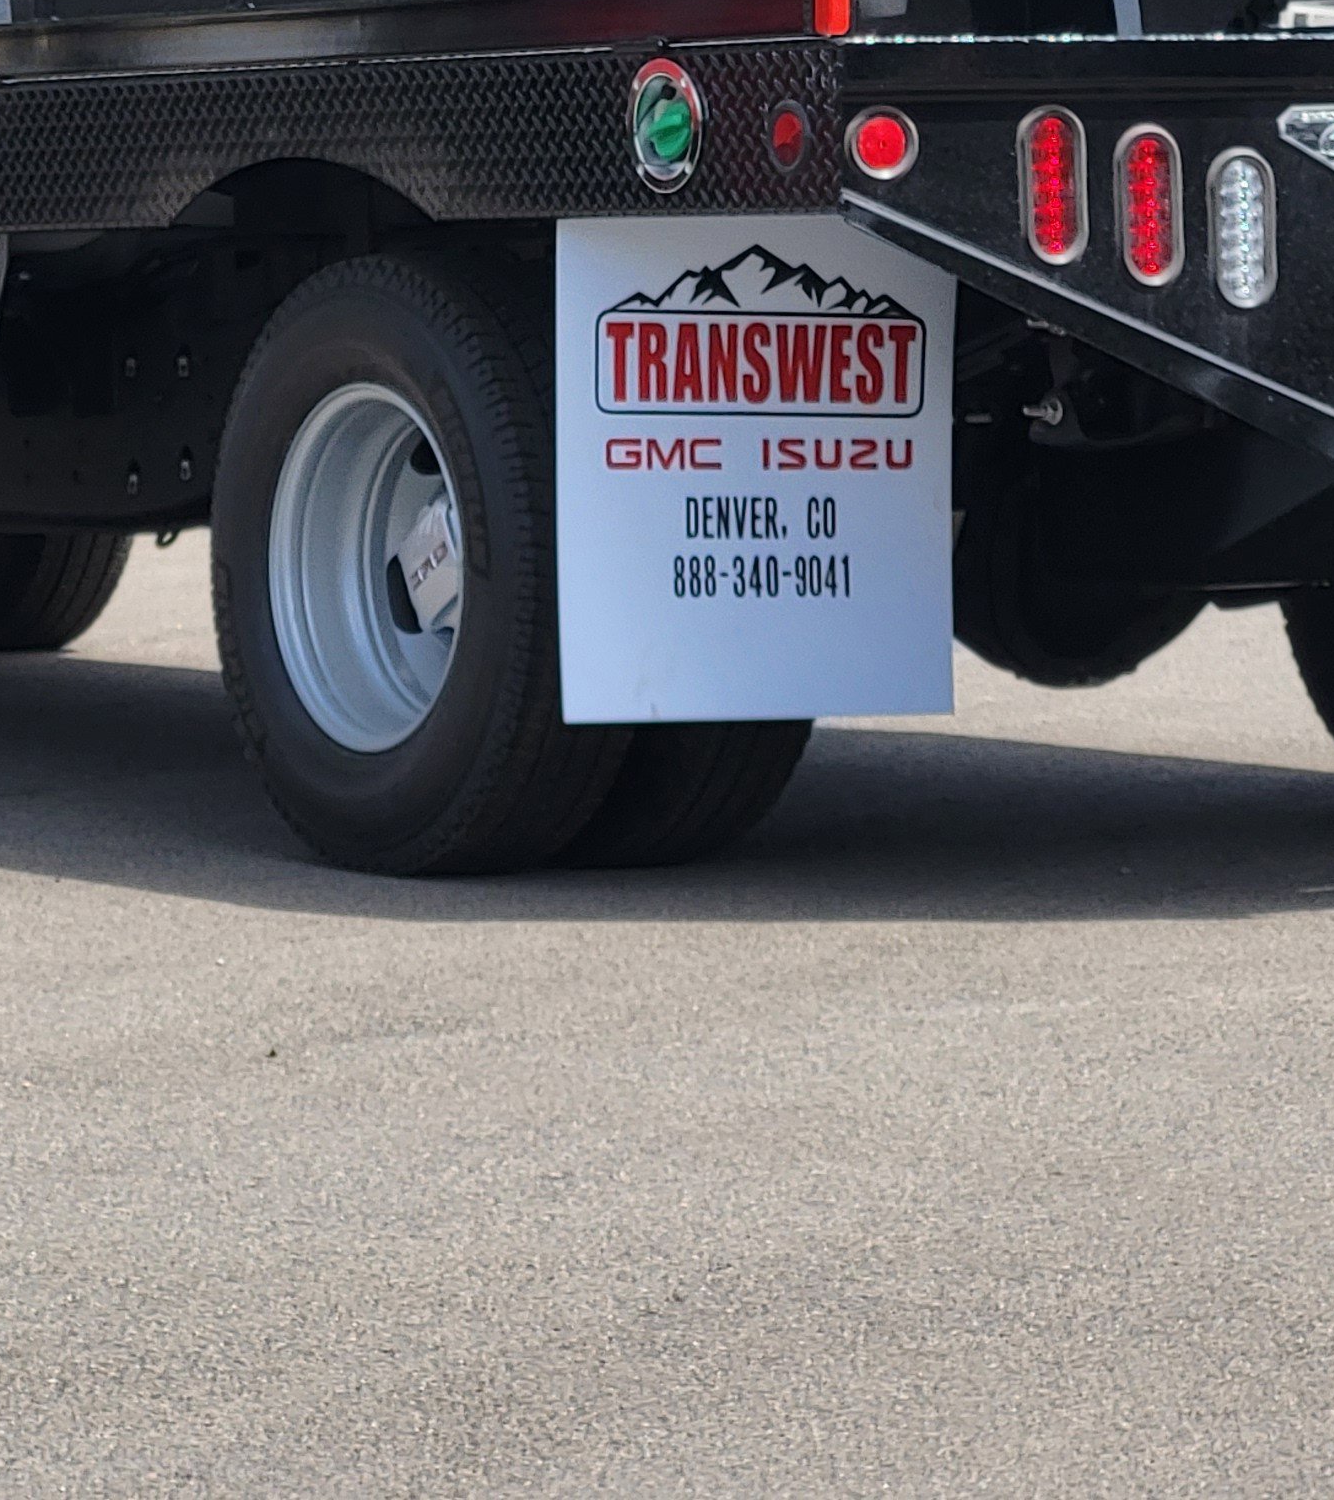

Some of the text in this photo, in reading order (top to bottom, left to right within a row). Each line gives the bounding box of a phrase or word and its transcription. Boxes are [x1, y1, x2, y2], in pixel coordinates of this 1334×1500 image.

[606, 321, 916, 404] TRANSWEST
[606, 438, 913, 471] GMC ISUZU
[686, 496, 836, 539] DENVER, CO
[674, 555, 850, 597] 888-340-9041
